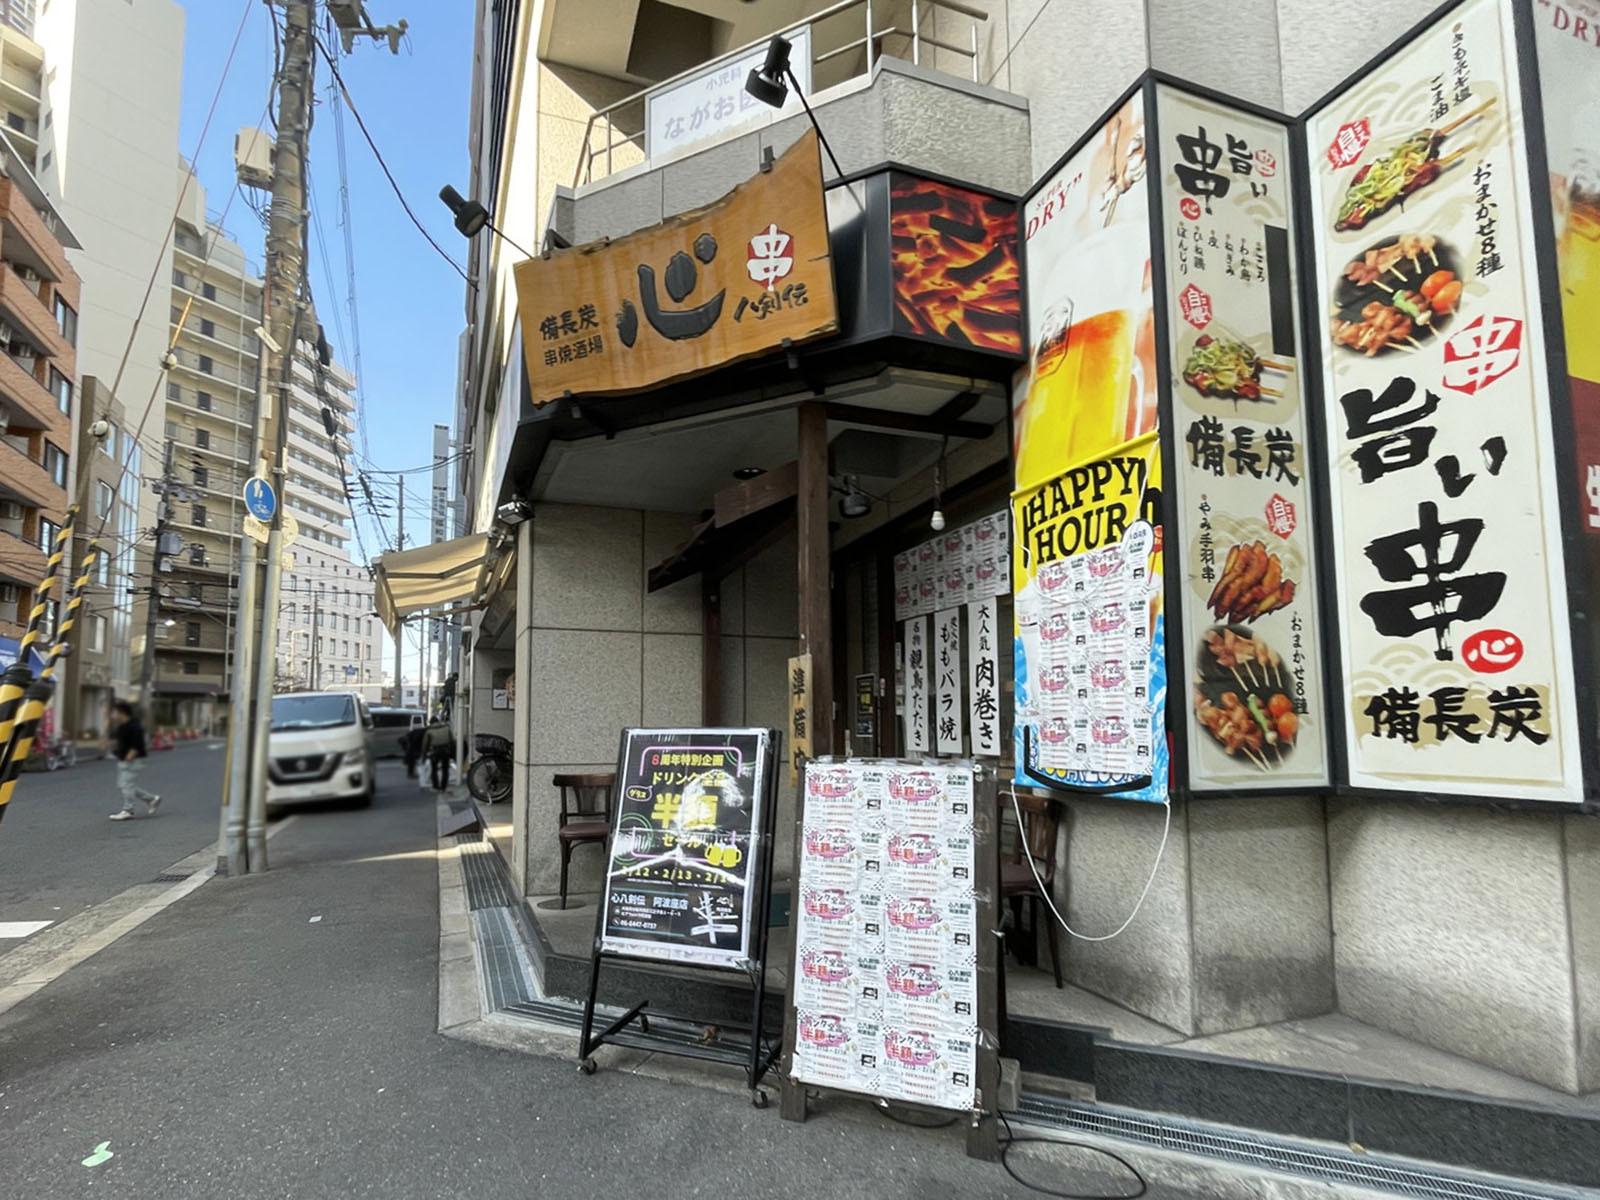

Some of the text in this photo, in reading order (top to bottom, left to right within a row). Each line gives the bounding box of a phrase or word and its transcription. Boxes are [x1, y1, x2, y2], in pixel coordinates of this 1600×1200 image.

[705, 66, 742, 91] 小児科
[1472, 163, 1505, 278] おまかせ8種
[616, 233, 727, 349] 心
[746, 223, 794, 292] 串
[539, 303, 600, 342] 備長炭
[734, 282, 810, 323] 八剣伝
[544, 334, 603, 367] 串焼酒場
[1442, 314, 1523, 396] 串
[1186, 415, 1299, 486] 備長炭
[1027, 456, 1139, 528] HAPPY
[1035, 502, 1128, 565] HOUR
[1360, 501, 1507, 661] 串
[939, 622, 957, 741] ももバラ焼
[973, 604, 998, 749] 大人気 肉巻き
[1292, 614, 1309, 715] おまかせ8種
[1467, 634, 1520, 665] 心
[1364, 686, 1549, 745] 備長炭
[651, 753, 725, 767] 8周年特別企画
